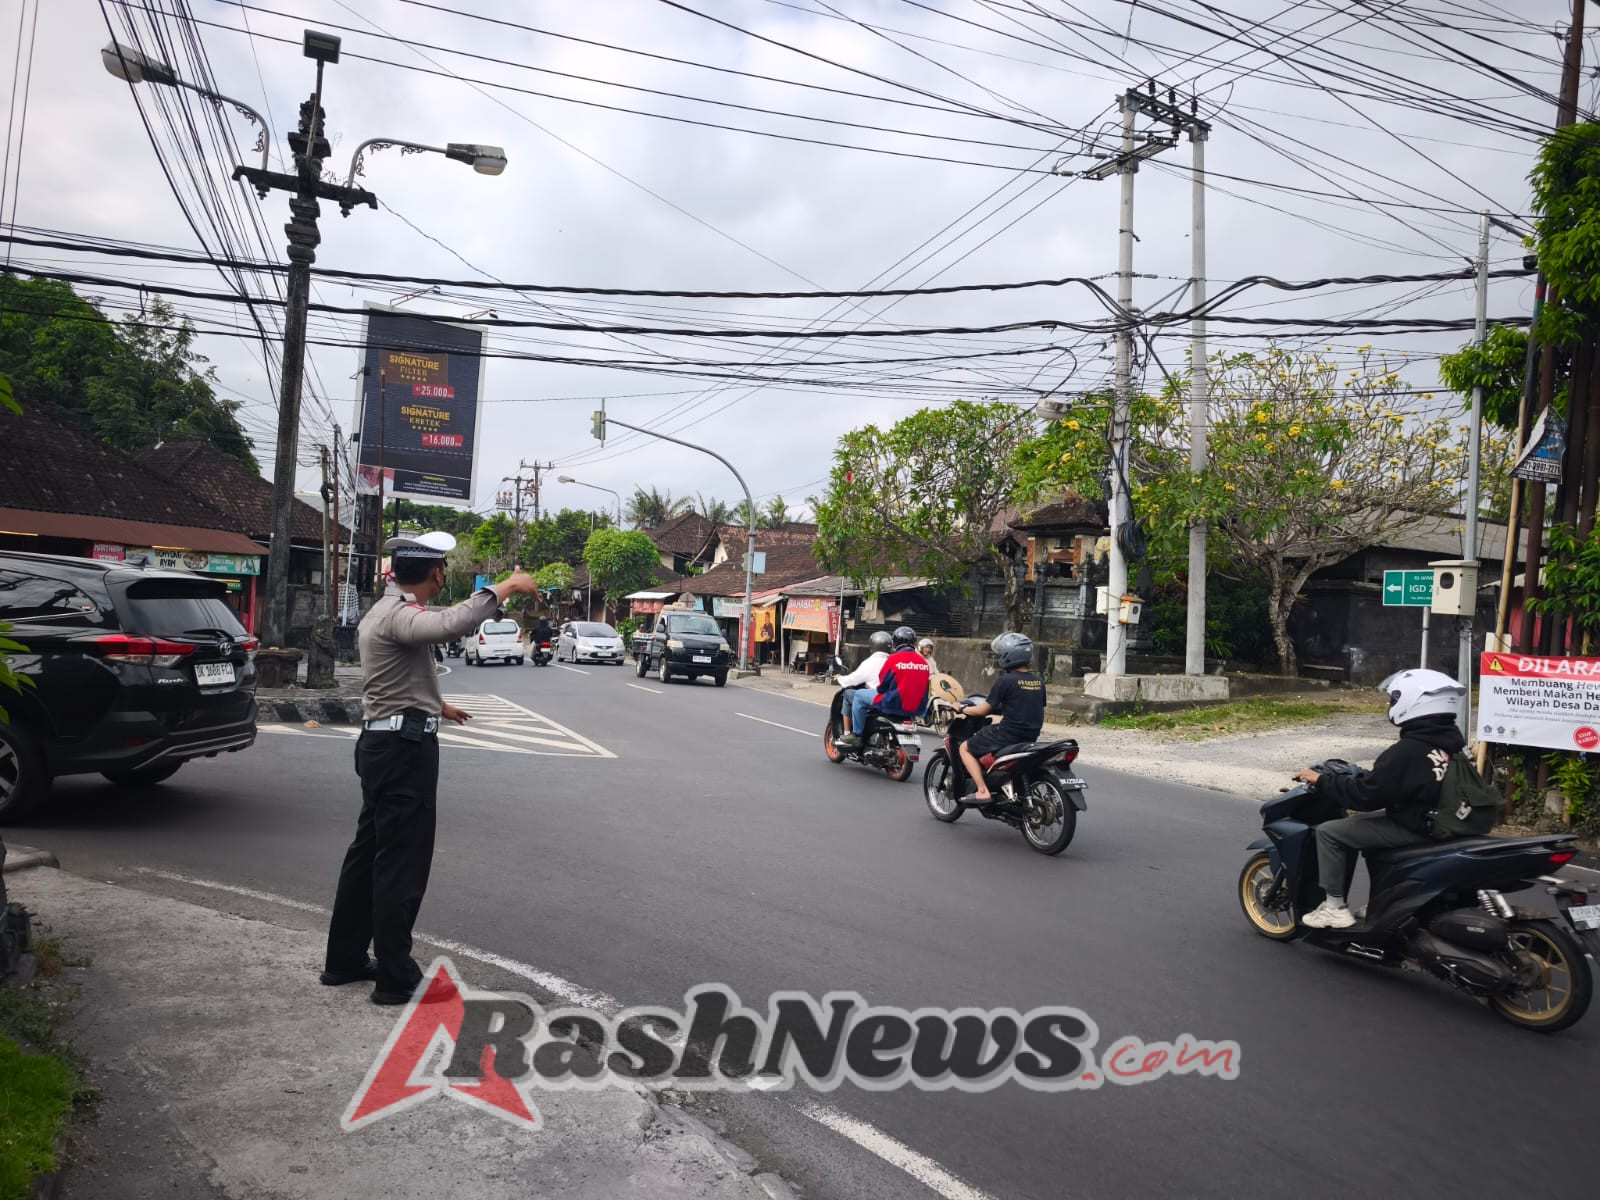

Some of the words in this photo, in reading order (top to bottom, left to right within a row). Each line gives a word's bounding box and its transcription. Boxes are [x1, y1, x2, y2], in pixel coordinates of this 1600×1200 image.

[389, 354, 440, 371] SIGNATURE
[400, 366, 428, 377] FILTER
[421, 385, 448, 398] 25.000
[401, 406, 451, 421] SIGNATURE
[409, 417, 441, 428] KRETEK
[429, 434, 455, 447] 16.000
[1409, 584, 1426, 593] IGD
[1511, 678, 1574, 691] Membuang
[1493, 686, 1540, 697] Memberi
[1543, 689, 1583, 699] Makan
[1506, 697, 1550, 708] Wilayah
[1553, 700, 1580, 710] Desa
[1584, 702, 1600, 711] Da
